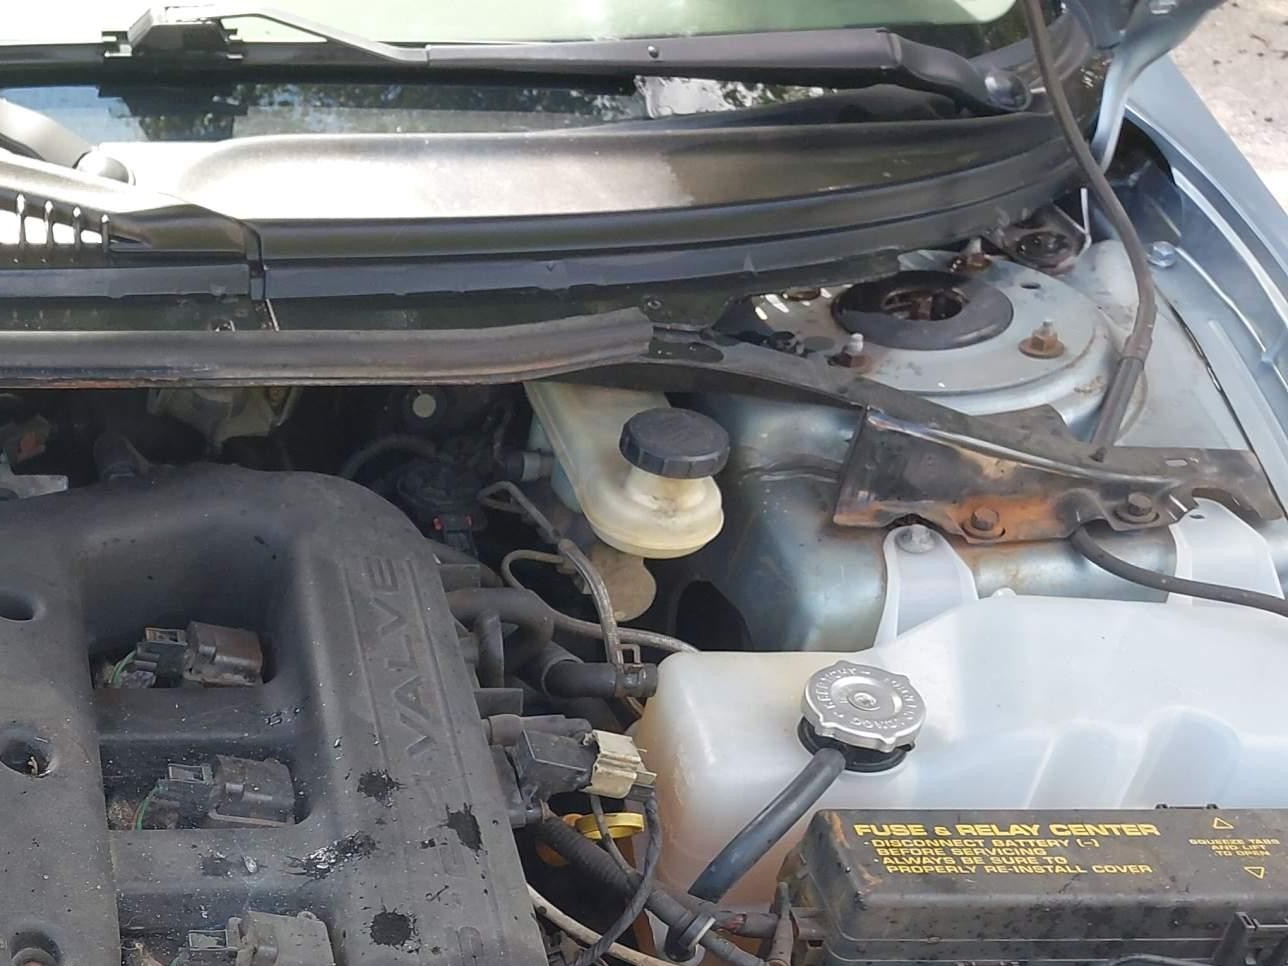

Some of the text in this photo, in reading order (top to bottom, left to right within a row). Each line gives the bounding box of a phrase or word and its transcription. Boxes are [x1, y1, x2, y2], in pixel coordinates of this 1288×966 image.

[854, 824, 1161, 836] FUSE & RELAY CENTER
[870, 839, 985, 847] DISCONNECT
[992, 839, 1069, 847] BATTERY
[876, 848, 1047, 856] BEFORE SERVICING
[883, 857, 1068, 865] ALWAYS BE SURE TO
[886, 865, 1153, 873] PROPERLY RE-INSTALL COVER
